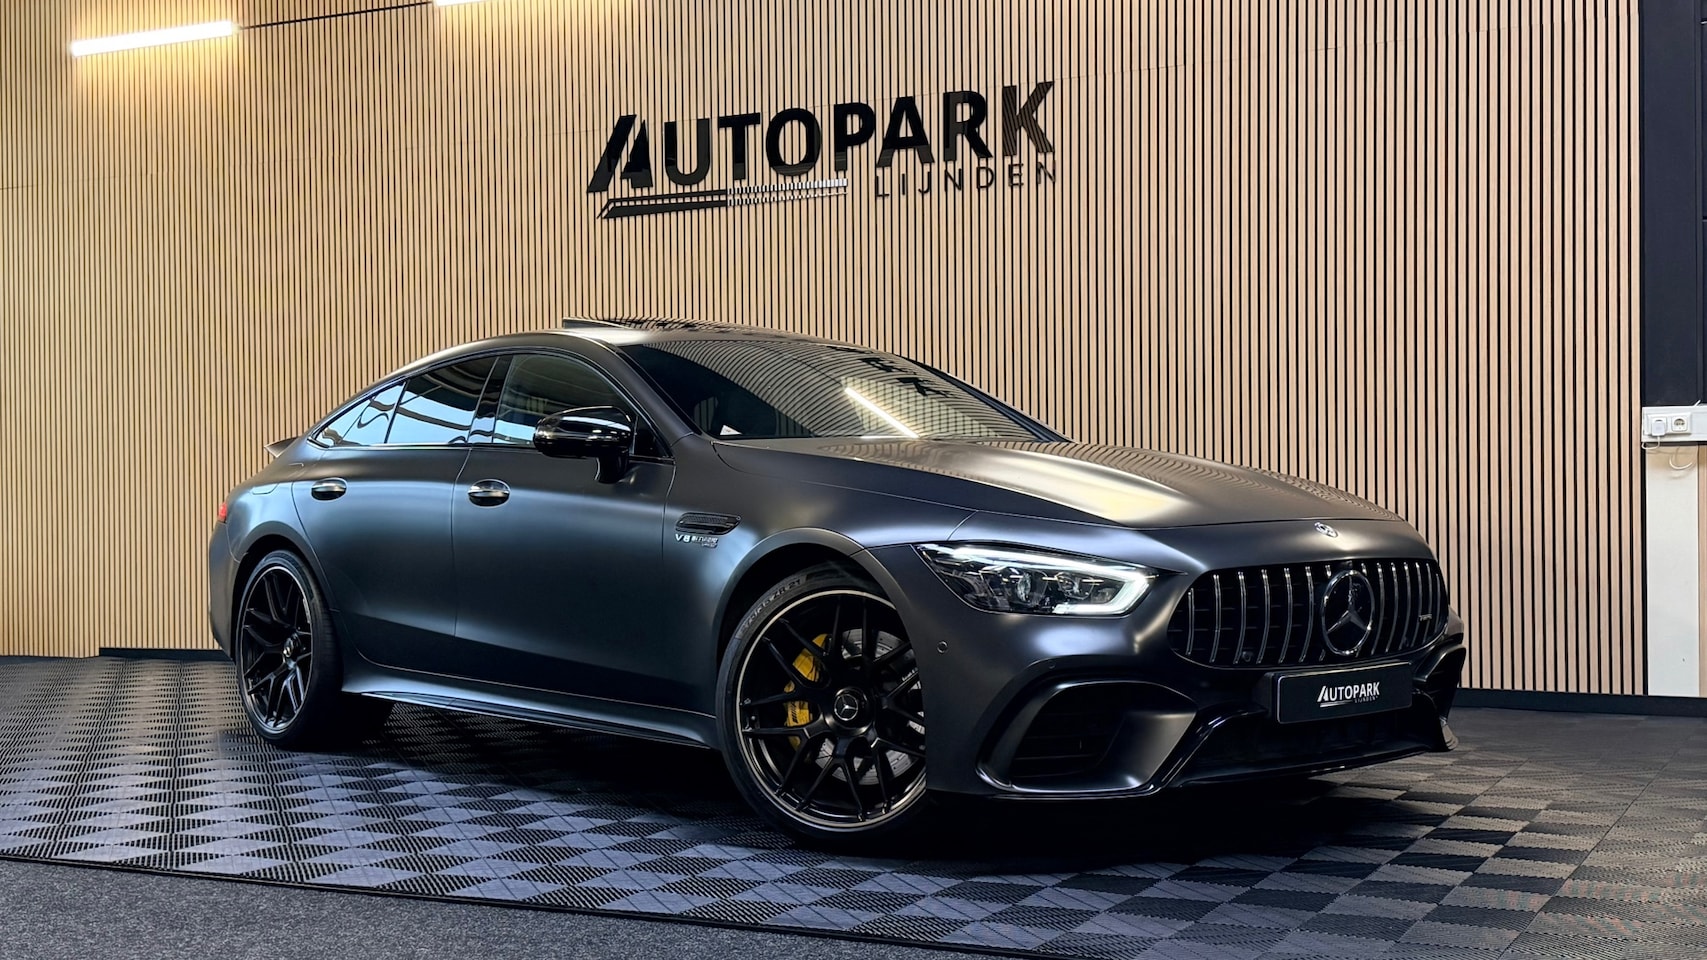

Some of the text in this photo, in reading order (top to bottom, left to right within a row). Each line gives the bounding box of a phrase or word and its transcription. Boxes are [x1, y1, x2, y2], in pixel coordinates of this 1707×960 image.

[586, 80, 1055, 193] AUTOPARK
[875, 159, 1057, 198] LIJNDEN
[675, 533, 691, 543] V8
[1317, 682, 1380, 701] AUTOPARK
